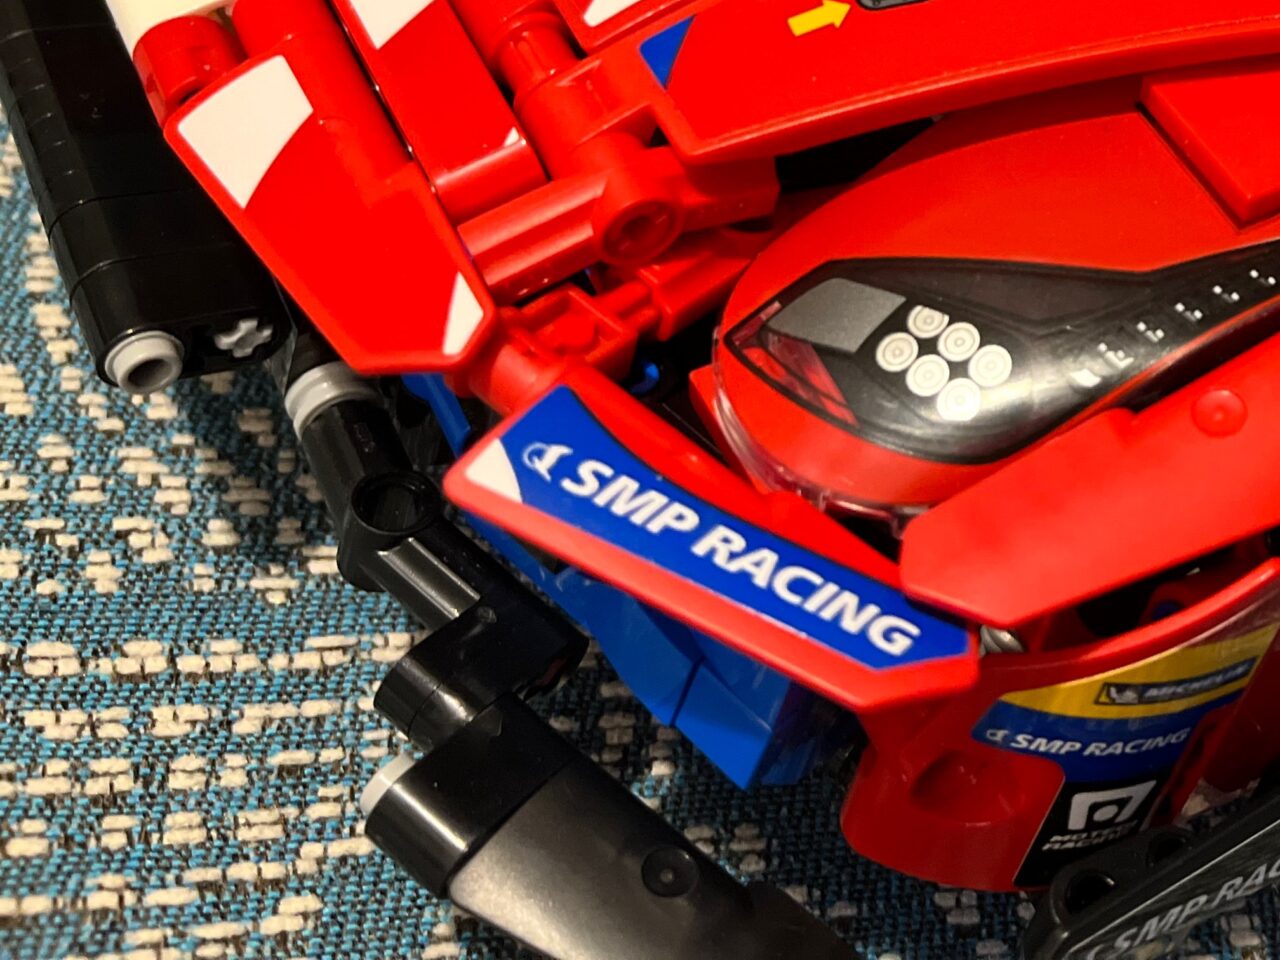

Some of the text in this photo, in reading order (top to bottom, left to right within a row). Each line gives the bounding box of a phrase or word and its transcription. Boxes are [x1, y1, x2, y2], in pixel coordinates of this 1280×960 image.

[560, 459, 922, 657] SMP RACING
[1010, 727, 1191, 757] SMP RACING
[1110, 895, 1208, 951] SMP
